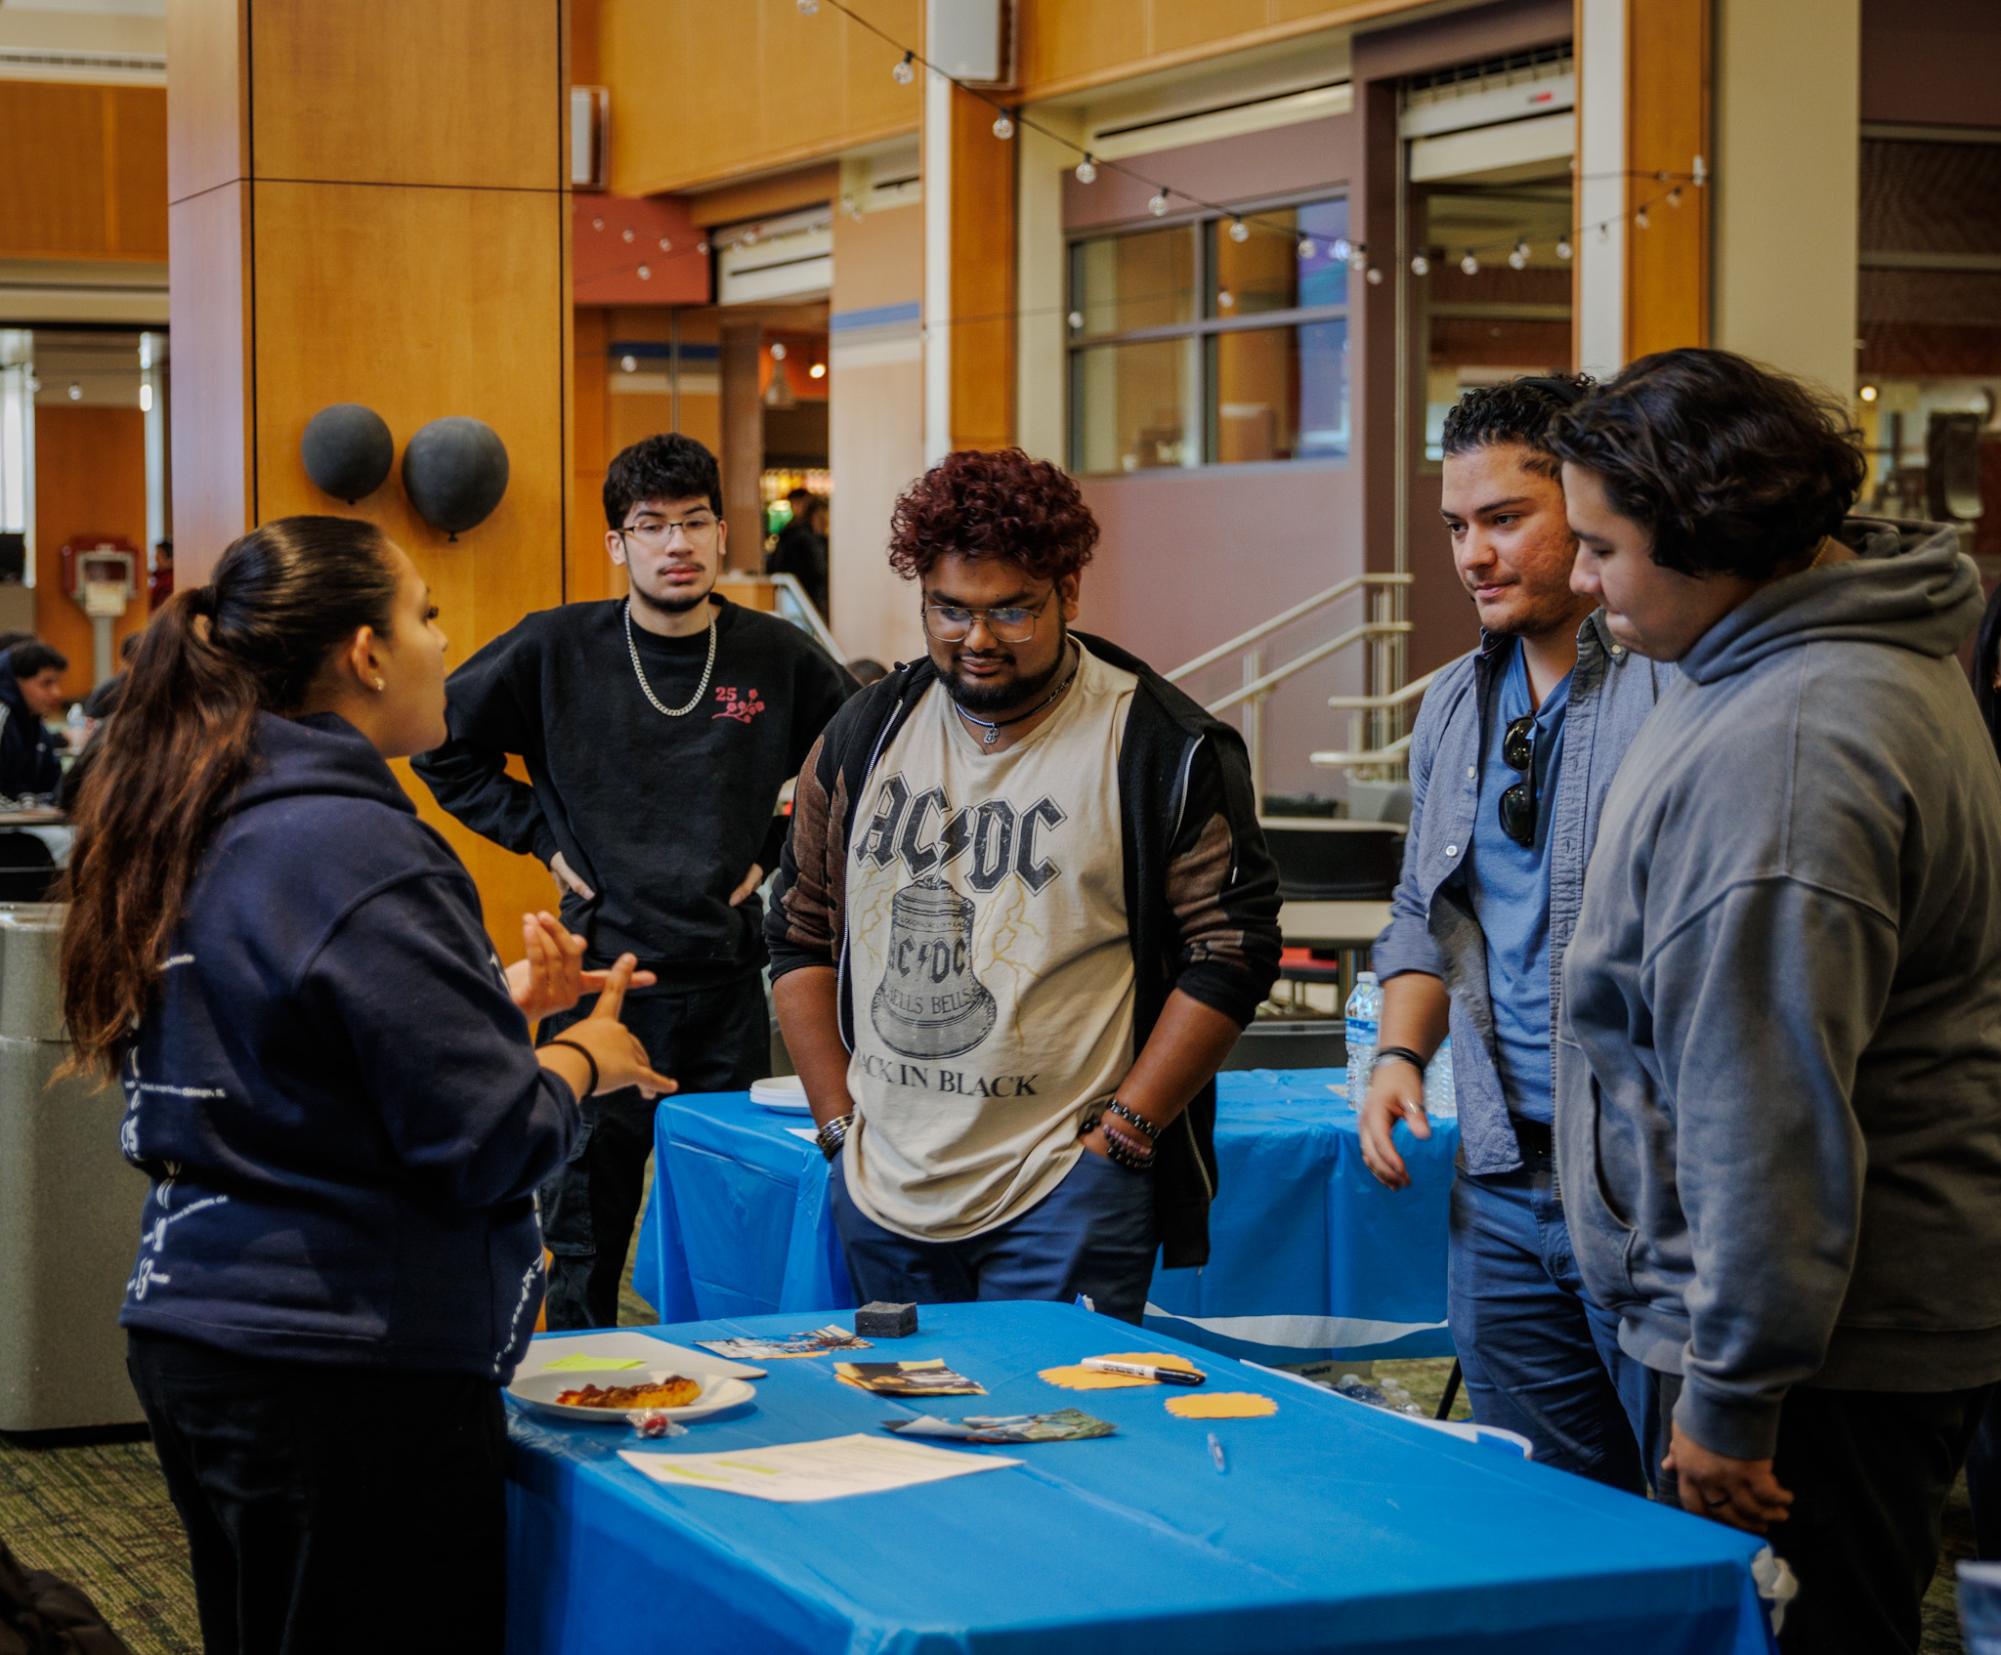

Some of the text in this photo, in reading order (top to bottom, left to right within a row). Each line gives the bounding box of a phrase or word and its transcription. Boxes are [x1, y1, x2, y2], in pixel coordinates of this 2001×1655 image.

[715, 686, 737, 702] 25
[931, 988, 972, 1015] BELLS
[900, 1063, 928, 1088] IN
[938, 1069, 1038, 1098] BLACK
